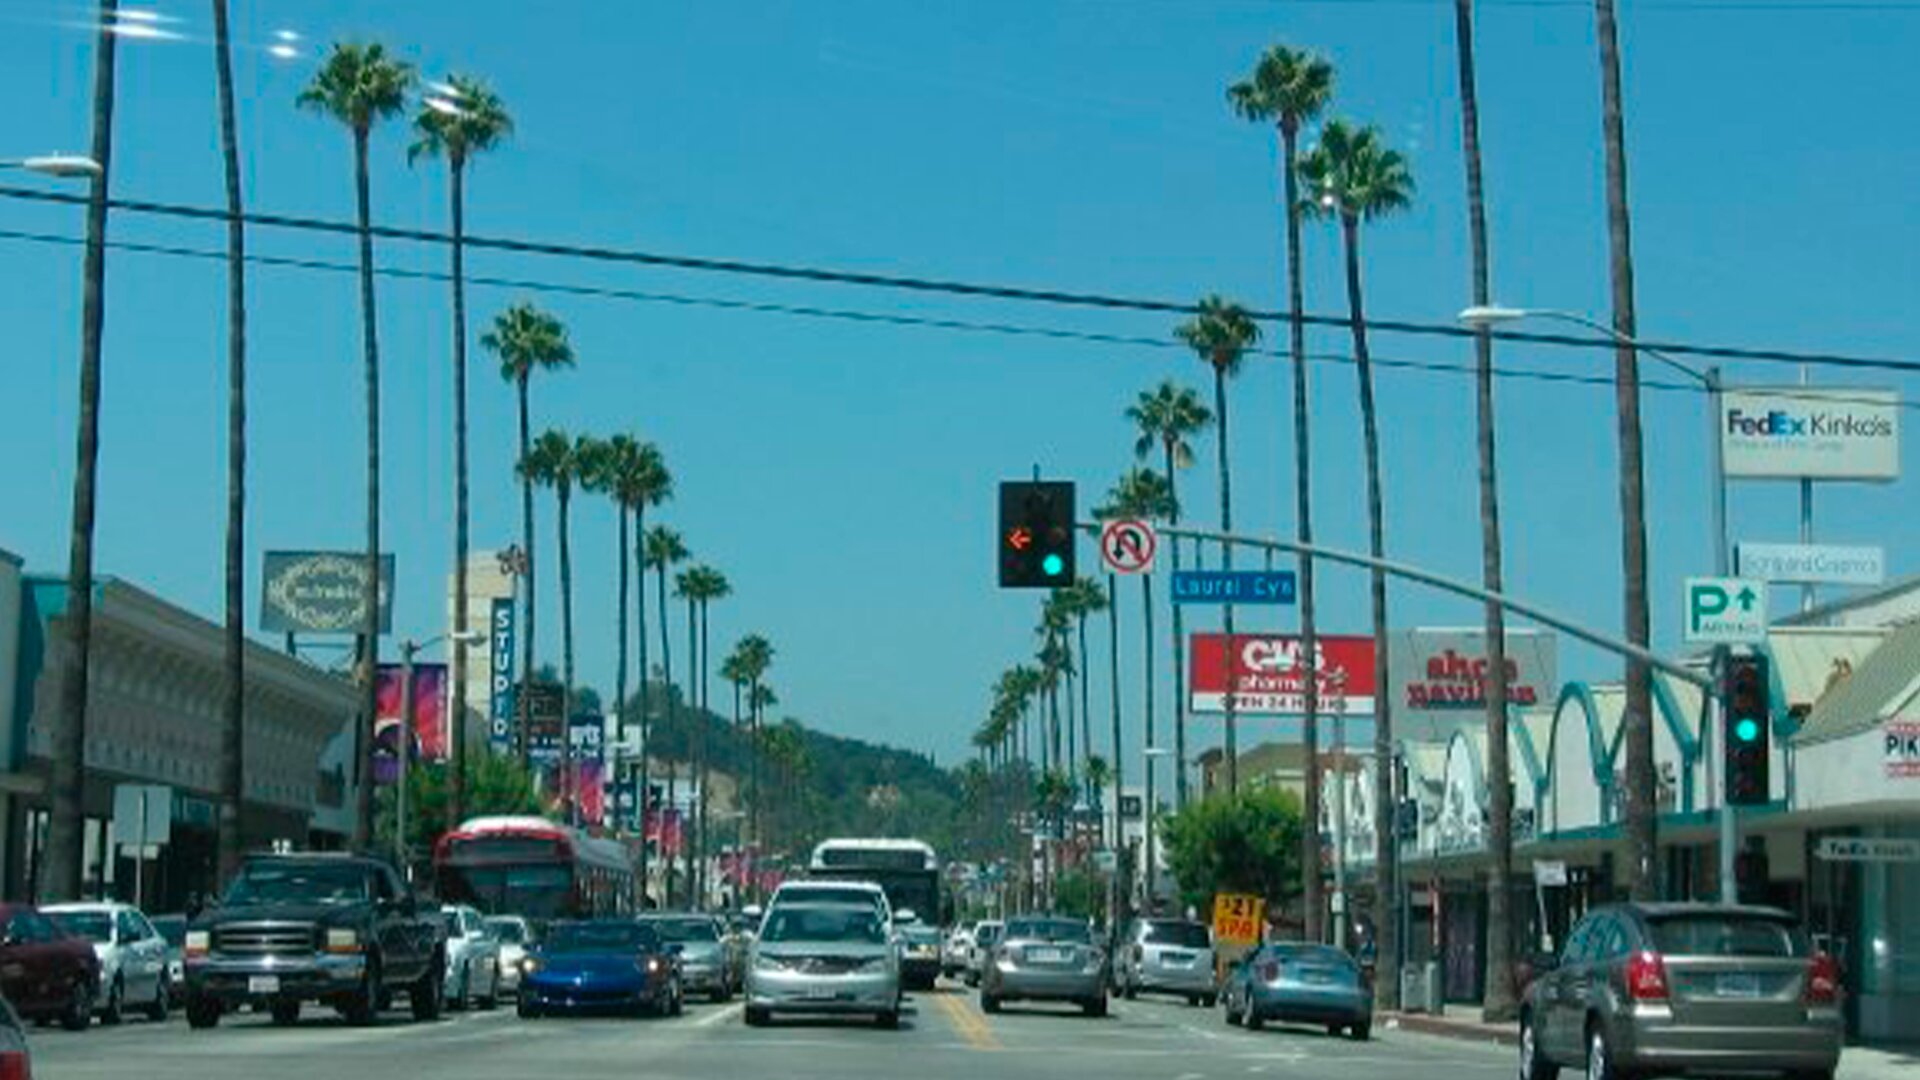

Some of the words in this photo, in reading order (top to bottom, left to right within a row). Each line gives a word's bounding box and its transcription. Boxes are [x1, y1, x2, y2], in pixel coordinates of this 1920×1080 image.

[1728, 409, 1805, 436] FedEx
[1810, 411, 1891, 437] Kinko's
[1175, 576, 1240, 595] Laurel
[1254, 576, 1293, 598] Cyn
[1241, 639, 1326, 671] CVS
[495, 608, 510, 736] STUDIO
[1238, 673, 1327, 696] pharmay
[1291, 697, 1347, 710] HURS
